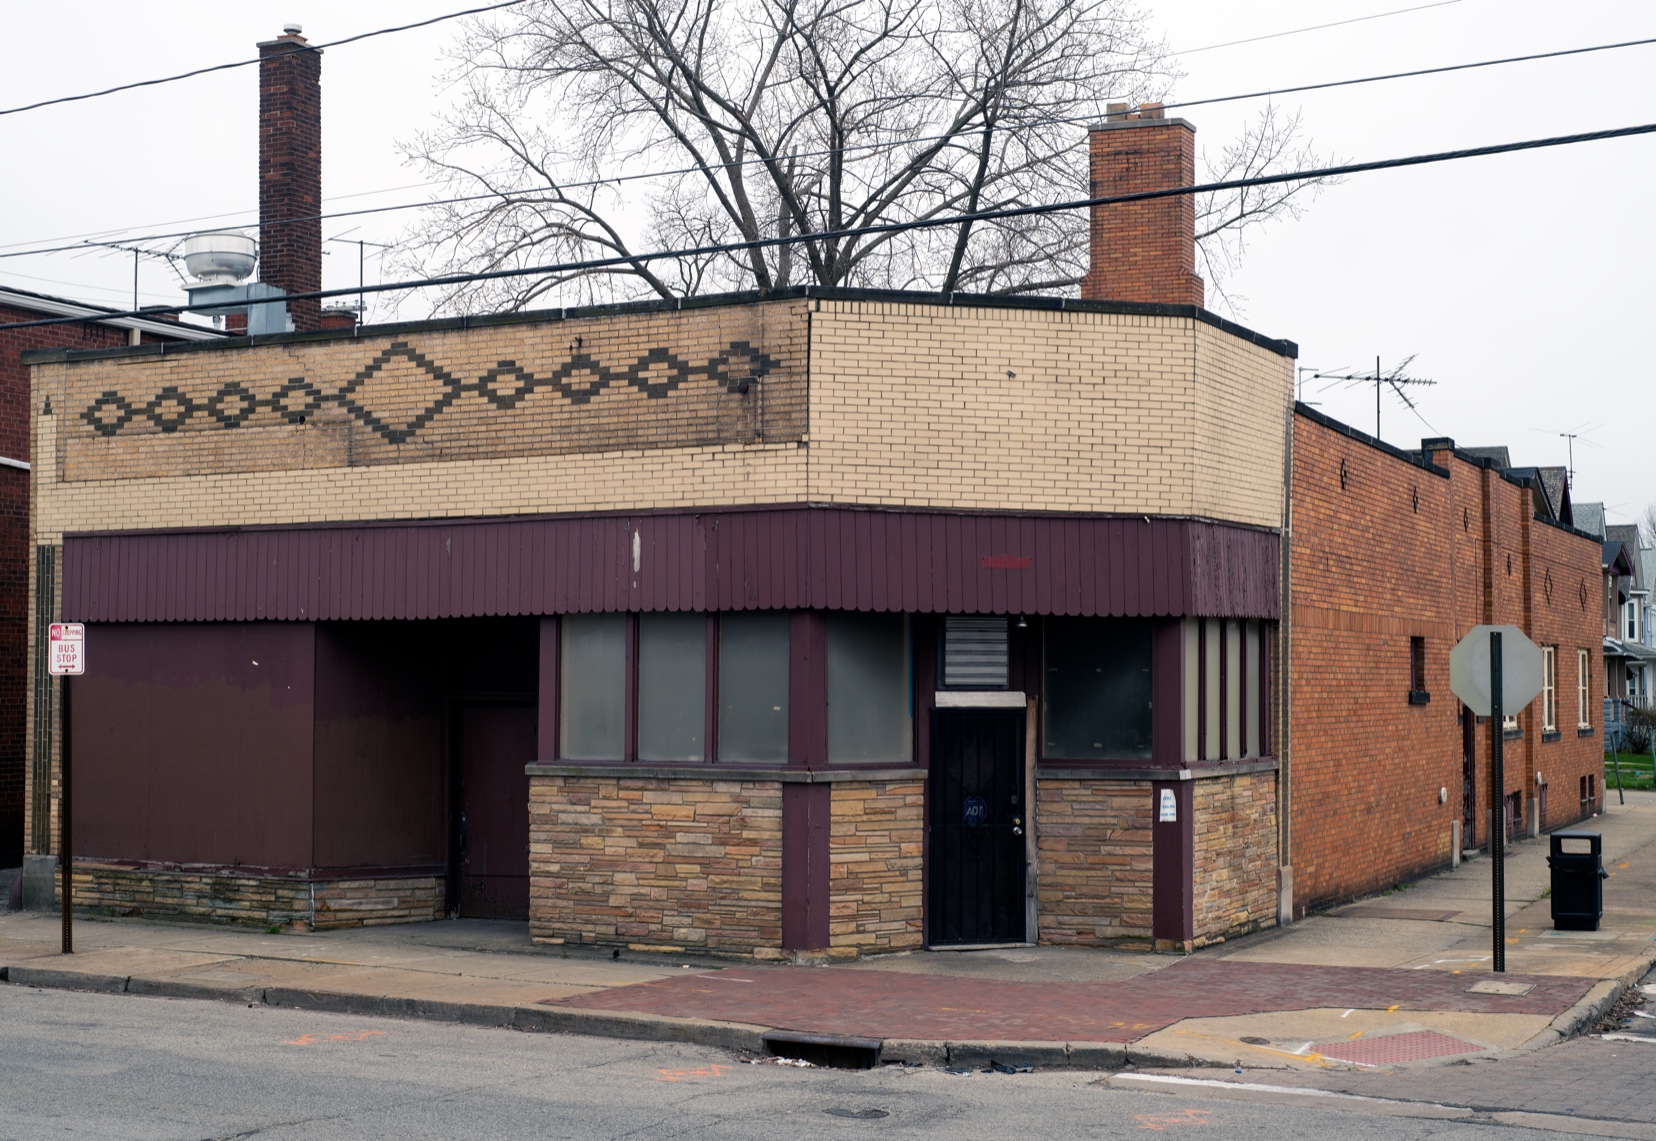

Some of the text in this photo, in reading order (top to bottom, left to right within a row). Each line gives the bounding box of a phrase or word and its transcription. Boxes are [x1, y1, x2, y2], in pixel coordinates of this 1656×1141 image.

[52, 628, 61, 637] NO
[59, 644, 75, 653] BUS
[56, 654, 77, 663] STOP
